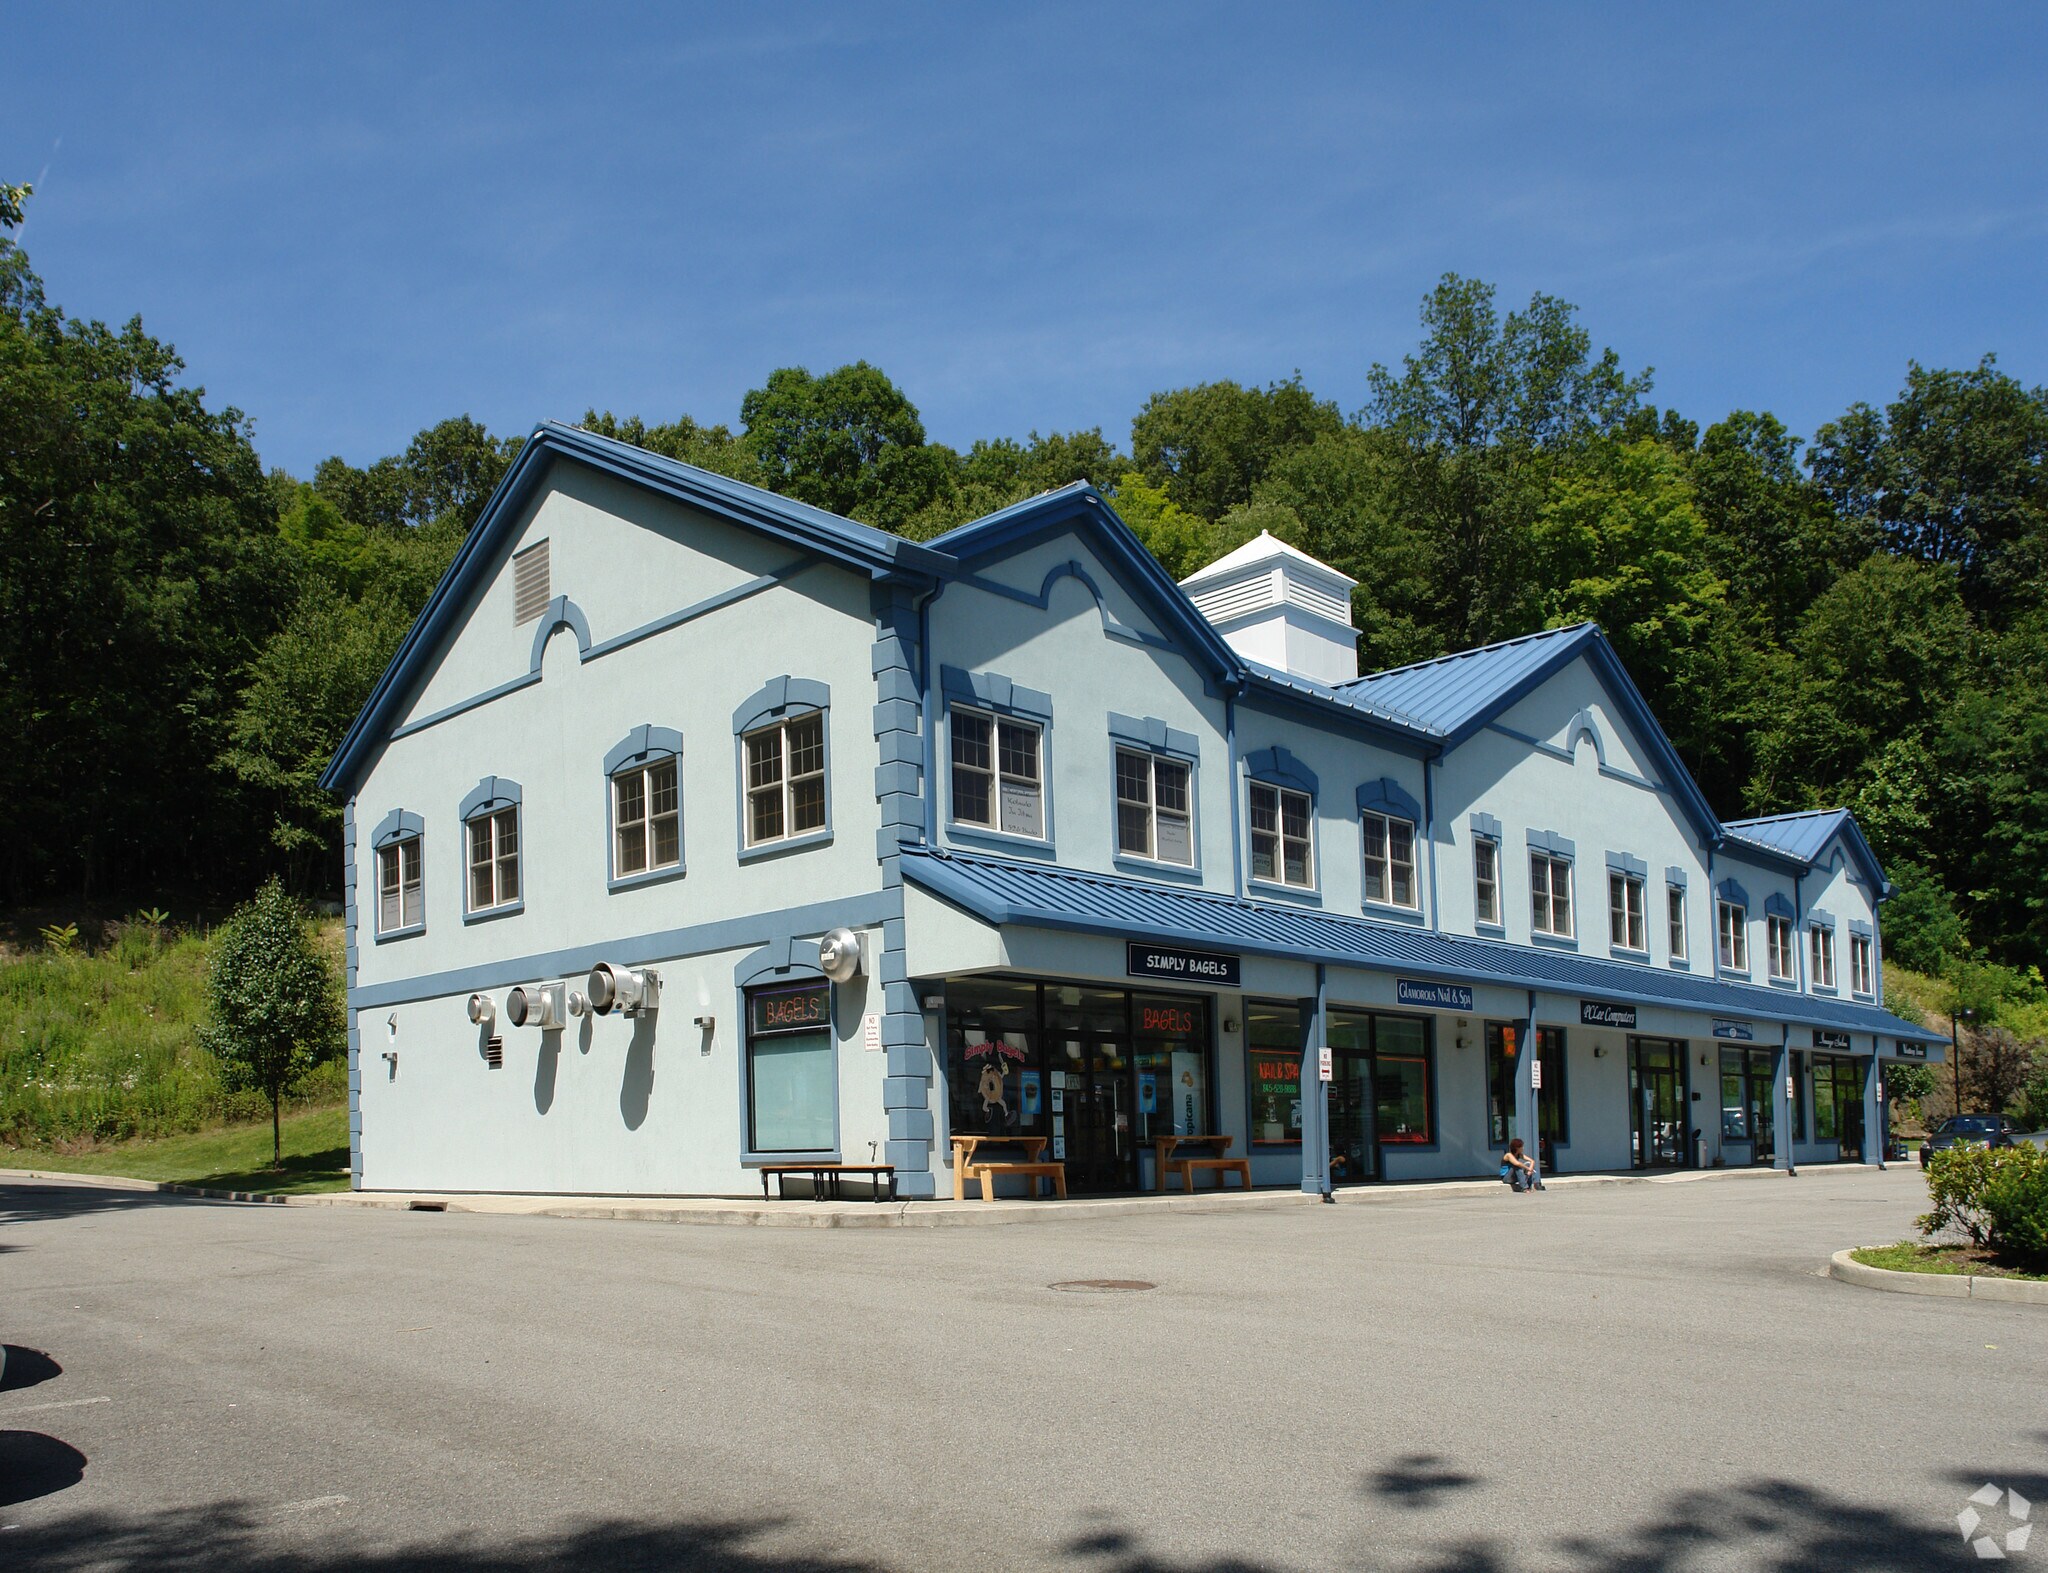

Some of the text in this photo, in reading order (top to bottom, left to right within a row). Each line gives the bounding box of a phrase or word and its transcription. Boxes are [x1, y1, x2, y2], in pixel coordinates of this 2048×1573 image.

[1146, 955, 1227, 975] SIMPLY BAGELS
[1452, 989, 1459, 1004] &
[766, 997, 820, 1024] BAGELS
[1143, 1008, 1192, 1032] BAGELS
[1604, 1006, 1635, 1027] Computers
[964, 1040, 1025, 1062] Simply Bagels
[1259, 1063, 1277, 1079] NAIL
[1284, 1063, 1299, 1079] SPA
